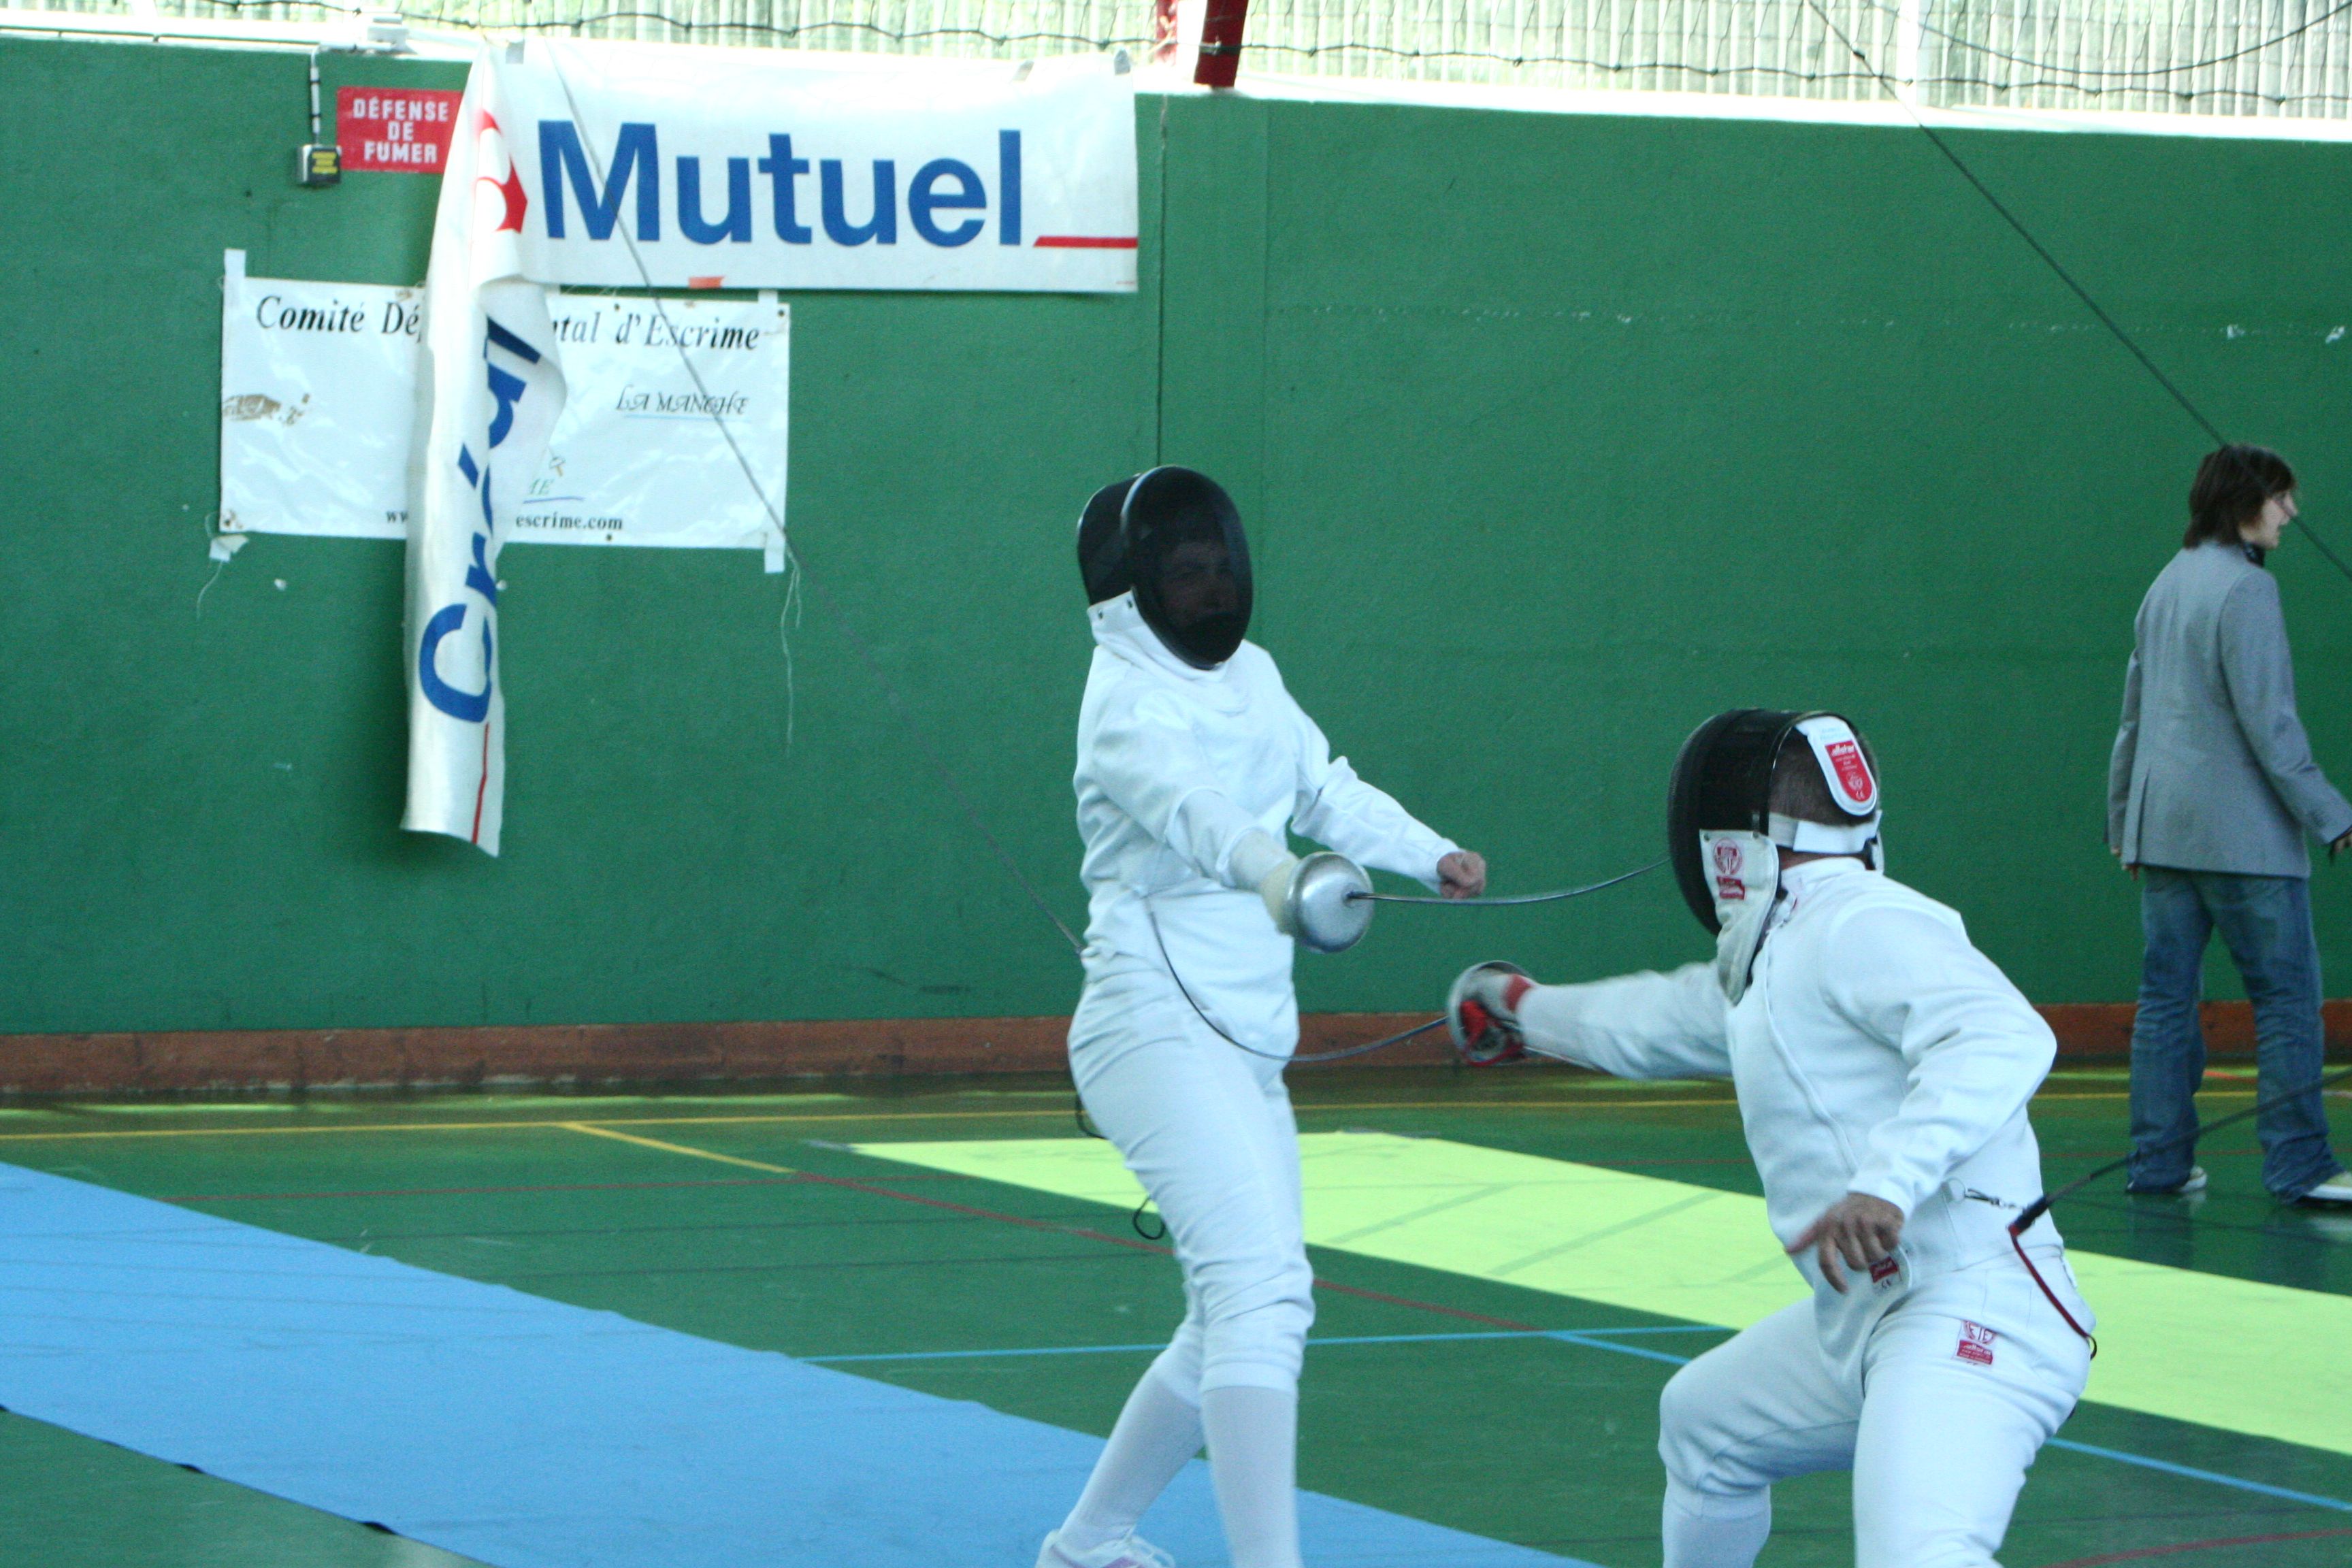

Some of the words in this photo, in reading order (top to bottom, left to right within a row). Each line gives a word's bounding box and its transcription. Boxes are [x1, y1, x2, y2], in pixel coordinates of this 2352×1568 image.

[353, 96, 449, 122] DÉFENSE
[387, 120, 414, 142] DE
[363, 140, 438, 164] FUMER
[538, 119, 1022, 248] Mutuel
[256, 295, 365, 333] Comité
[615, 312, 760, 350] d'Escrime
